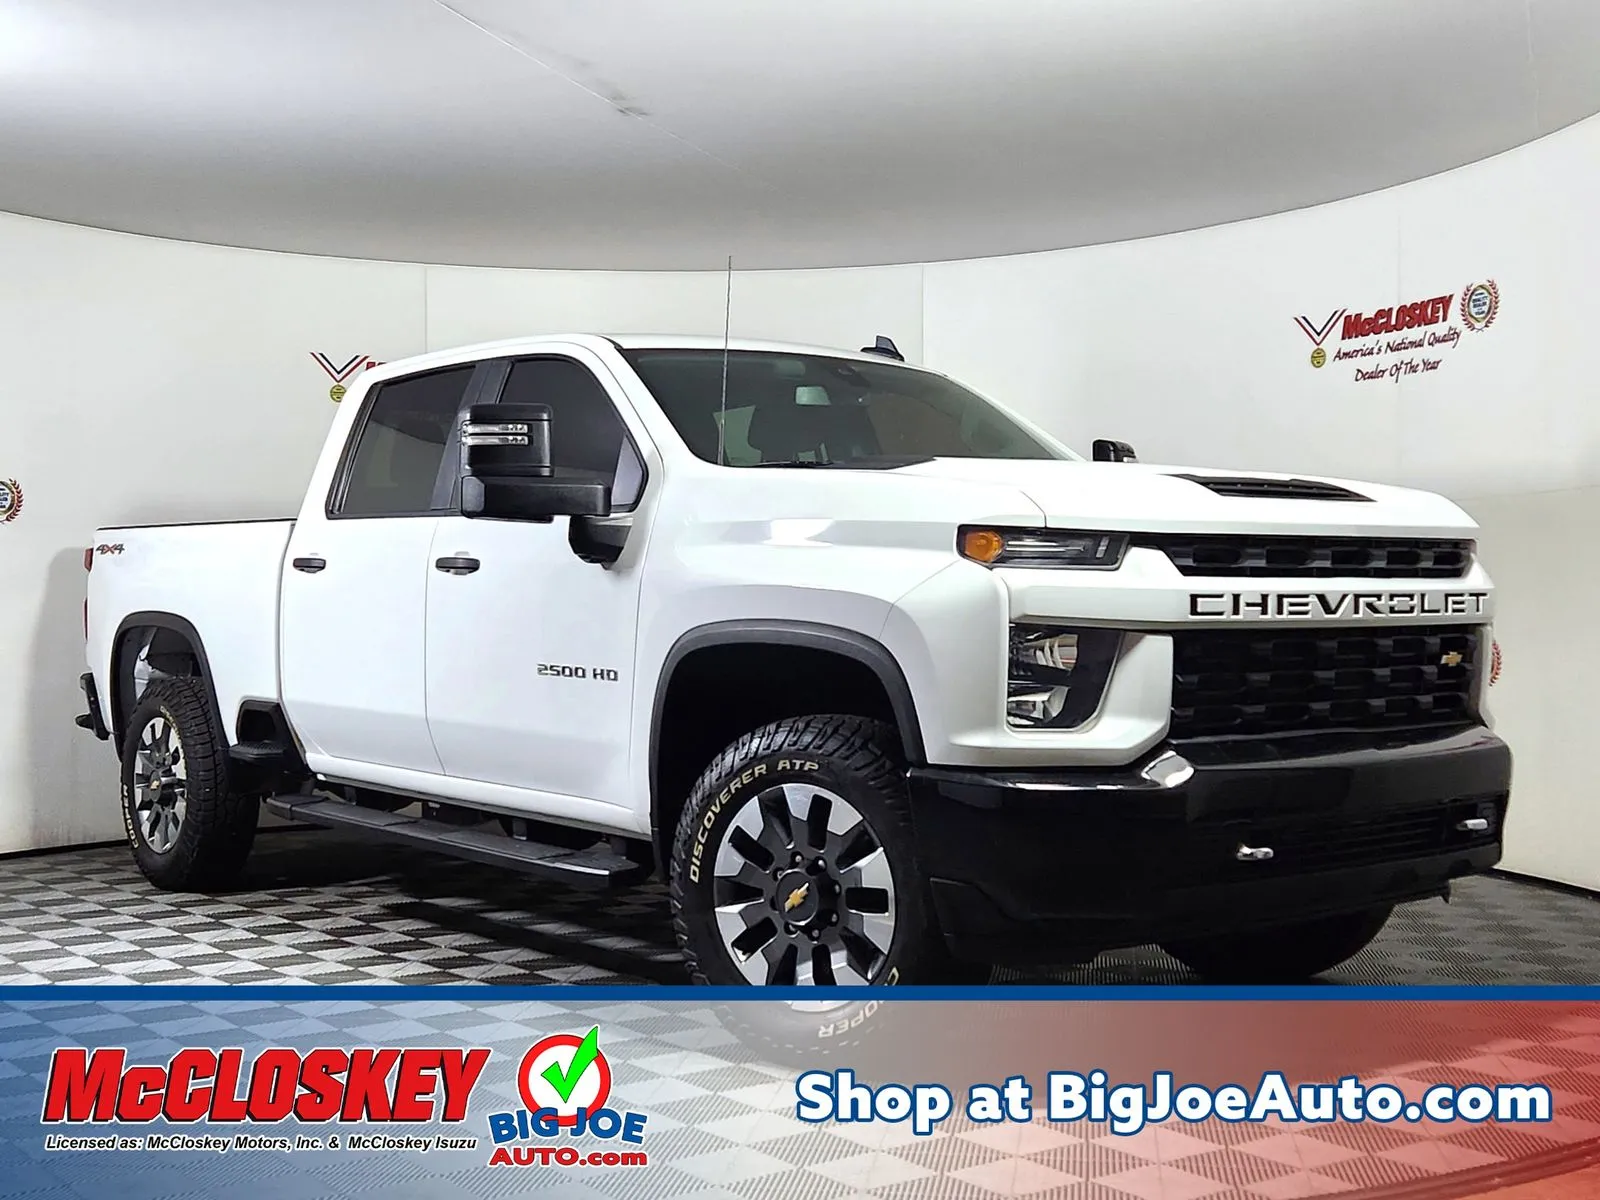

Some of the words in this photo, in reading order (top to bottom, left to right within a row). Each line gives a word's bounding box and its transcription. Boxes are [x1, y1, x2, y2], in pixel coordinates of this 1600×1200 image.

[1341, 294, 1455, 341] McCLOSKEY
[1333, 340, 1383, 362] America's
[1384, 330, 1426, 354] National
[1427, 325, 1463, 349] Quality
[1354, 365, 1389, 383] Dealer
[1389, 360, 1404, 384] Of
[1404, 358, 1421, 376] The
[1421, 358, 1443, 372] Year
[1188, 592, 1490, 619] CHEVROLET
[536, 663, 587, 679] 2500
[592, 667, 619, 682] HD
[689, 763, 768, 884] DISCOVERER
[777, 759, 820, 772] ATP
